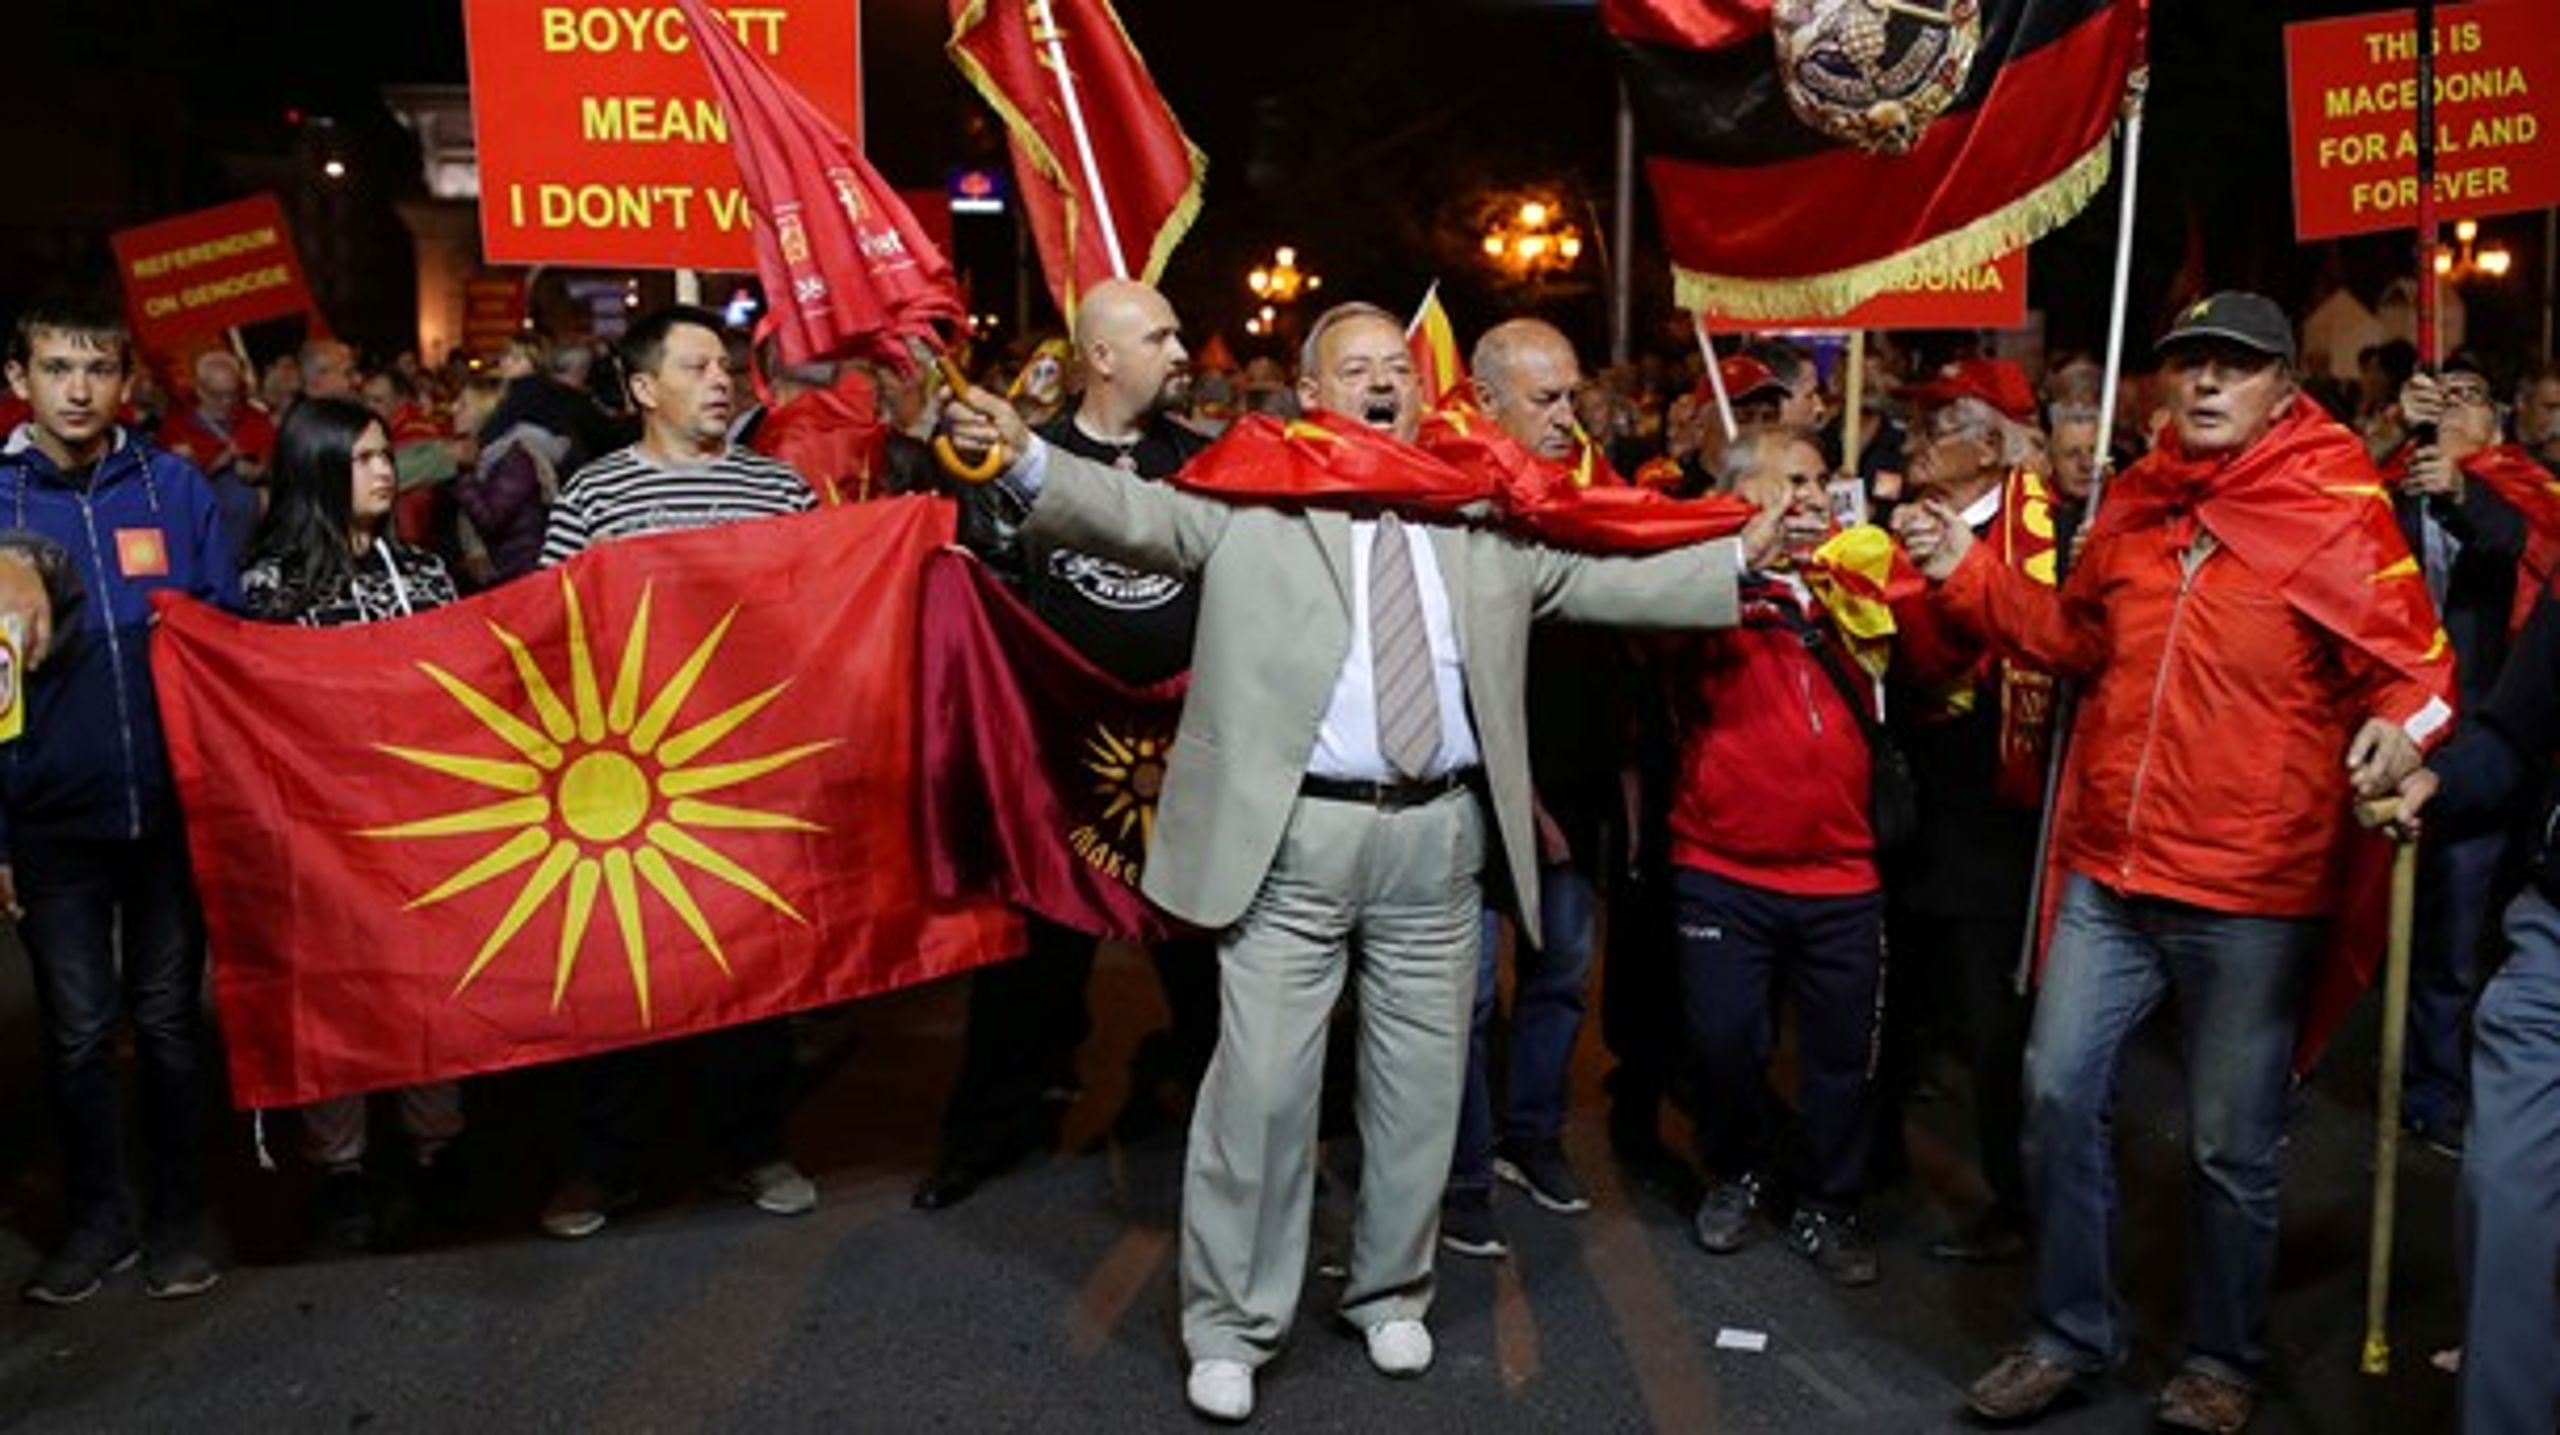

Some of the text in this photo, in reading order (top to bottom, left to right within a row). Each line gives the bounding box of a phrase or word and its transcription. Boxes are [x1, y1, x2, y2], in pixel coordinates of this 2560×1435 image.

[543, 8, 786, 54] BOYCTT
[2450, 23, 2481, 54] IS
[2319, 114, 2537, 168] FOR AL AND
[510, 184, 752, 231] I DON'T V
[133, 226, 276, 277] REFERENDUM
[144, 265, 289, 318] ON GENOCIDE
